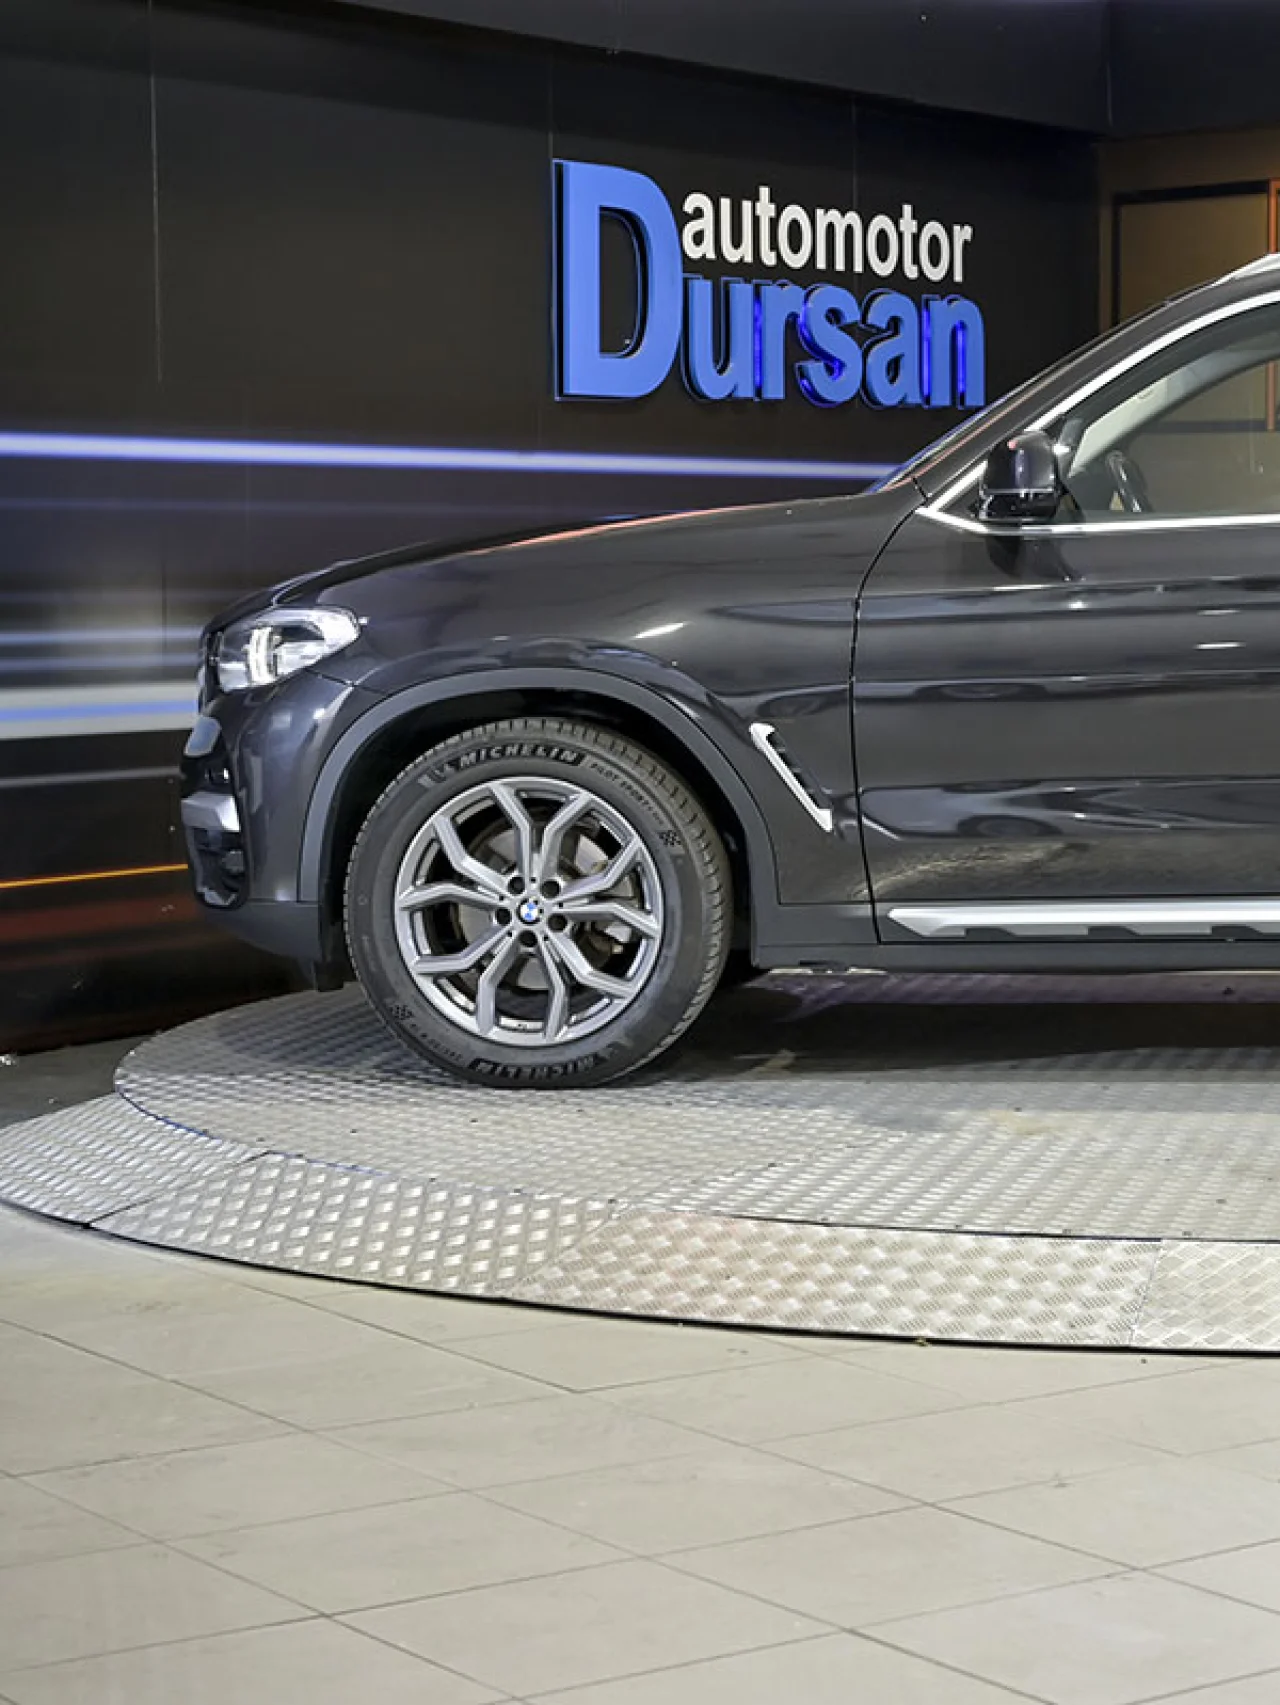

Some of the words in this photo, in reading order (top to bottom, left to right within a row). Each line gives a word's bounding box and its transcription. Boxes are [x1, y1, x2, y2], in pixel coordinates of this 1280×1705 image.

[682, 185, 973, 283] automotor
[552, 158, 986, 410] Dursan
[459, 743, 578, 769] MICHELIN
